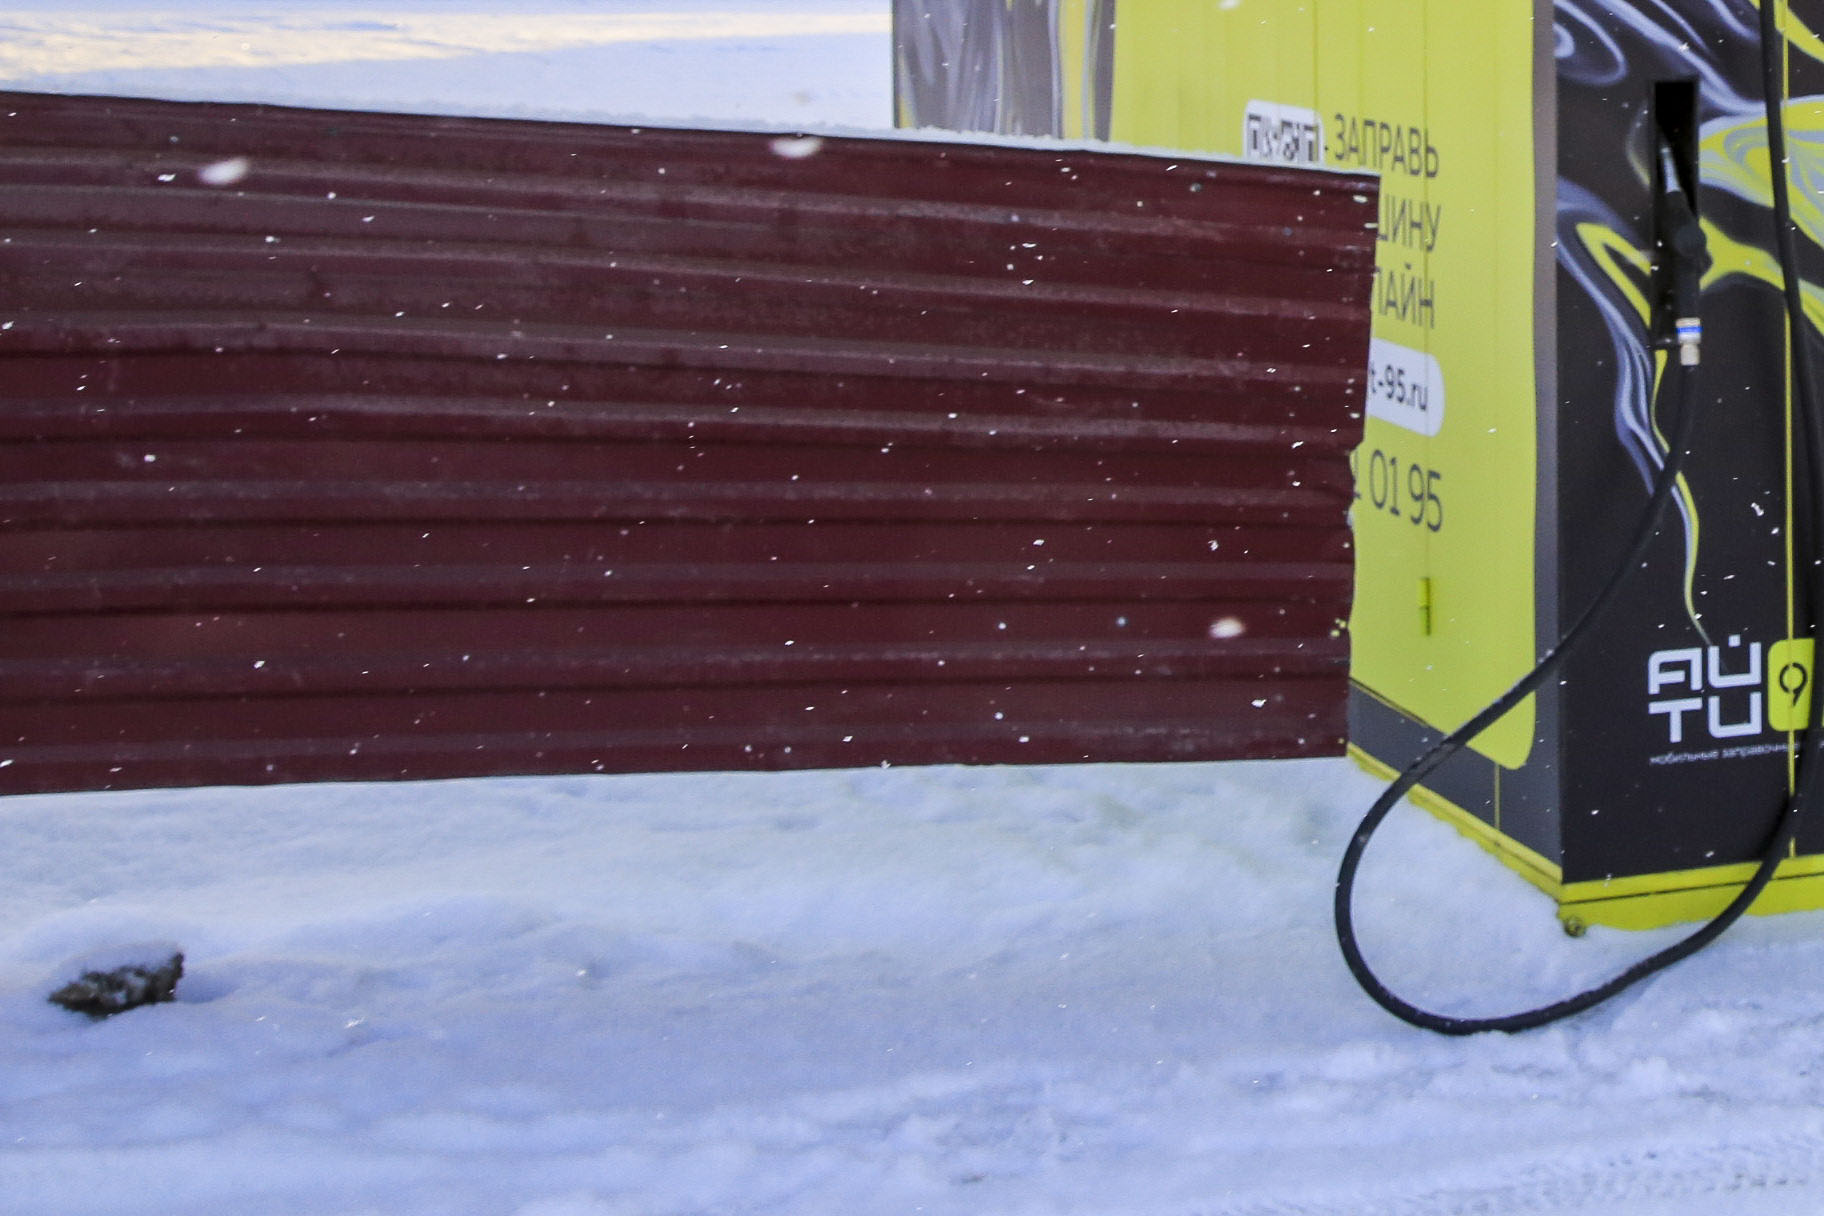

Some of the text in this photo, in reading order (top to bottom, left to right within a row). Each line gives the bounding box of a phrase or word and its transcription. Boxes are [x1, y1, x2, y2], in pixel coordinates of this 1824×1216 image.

[1334, 112, 1440, 179] ЗАПРАВЬ
[1369, 448, 1400, 517] 01
[1408, 463, 1443, 533] 95
